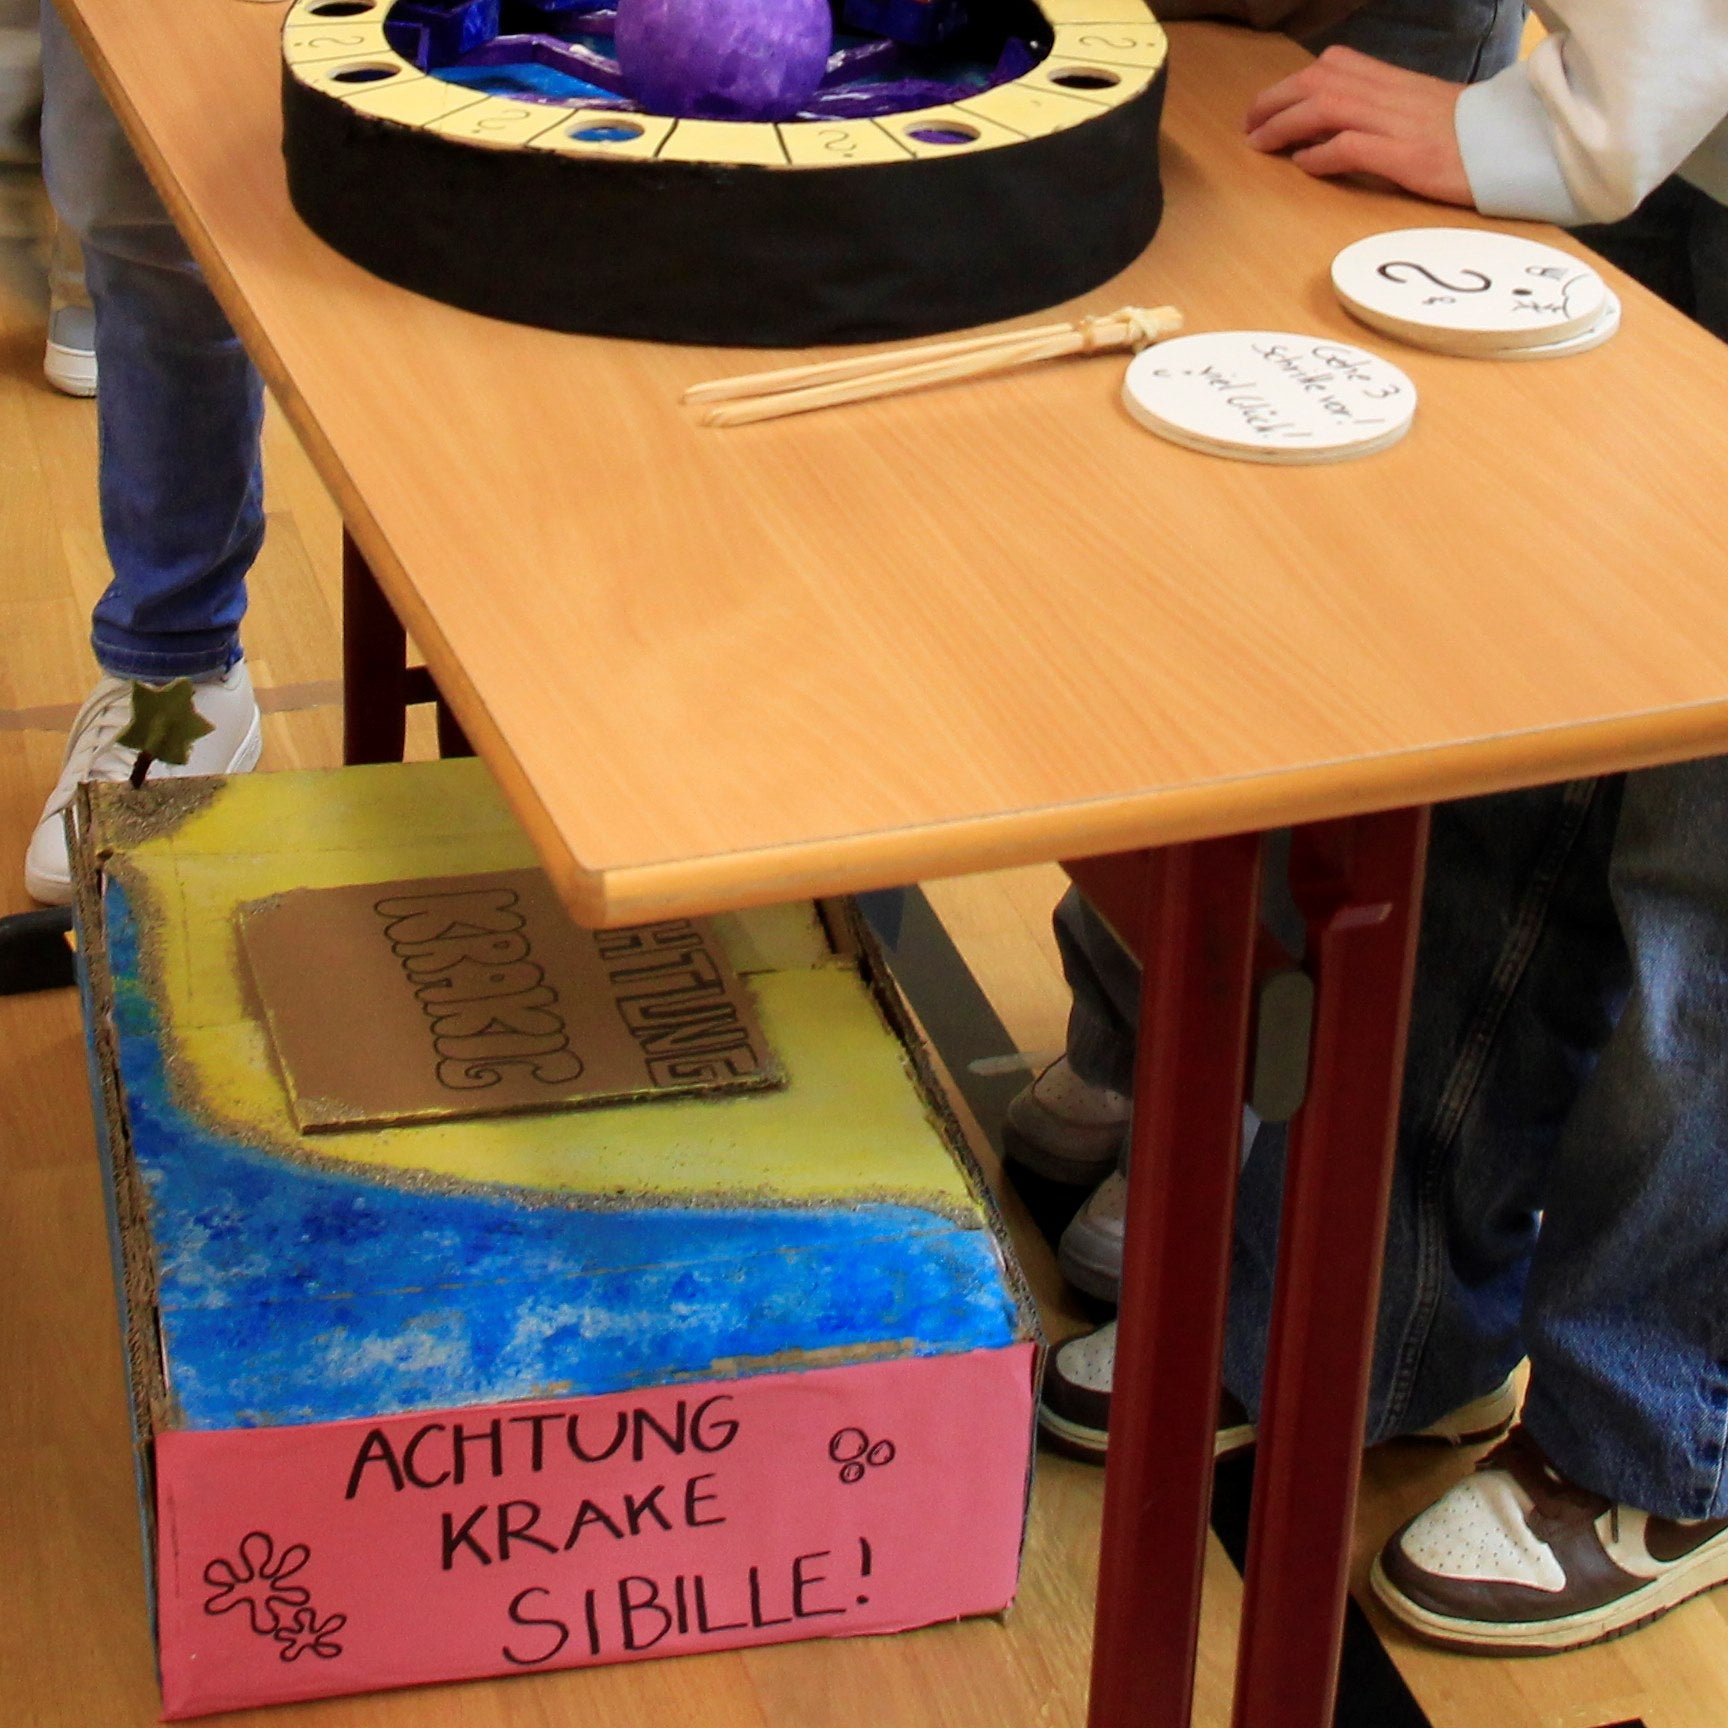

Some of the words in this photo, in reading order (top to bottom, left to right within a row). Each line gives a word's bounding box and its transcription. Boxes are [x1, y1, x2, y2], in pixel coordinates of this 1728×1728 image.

[592, 918, 761, 1088] HTUNG
[344, 1394, 741, 1500] ACHTUNG
[441, 1472, 727, 1571] KRAKE
[502, 1536, 873, 1666] SIBILLE!
